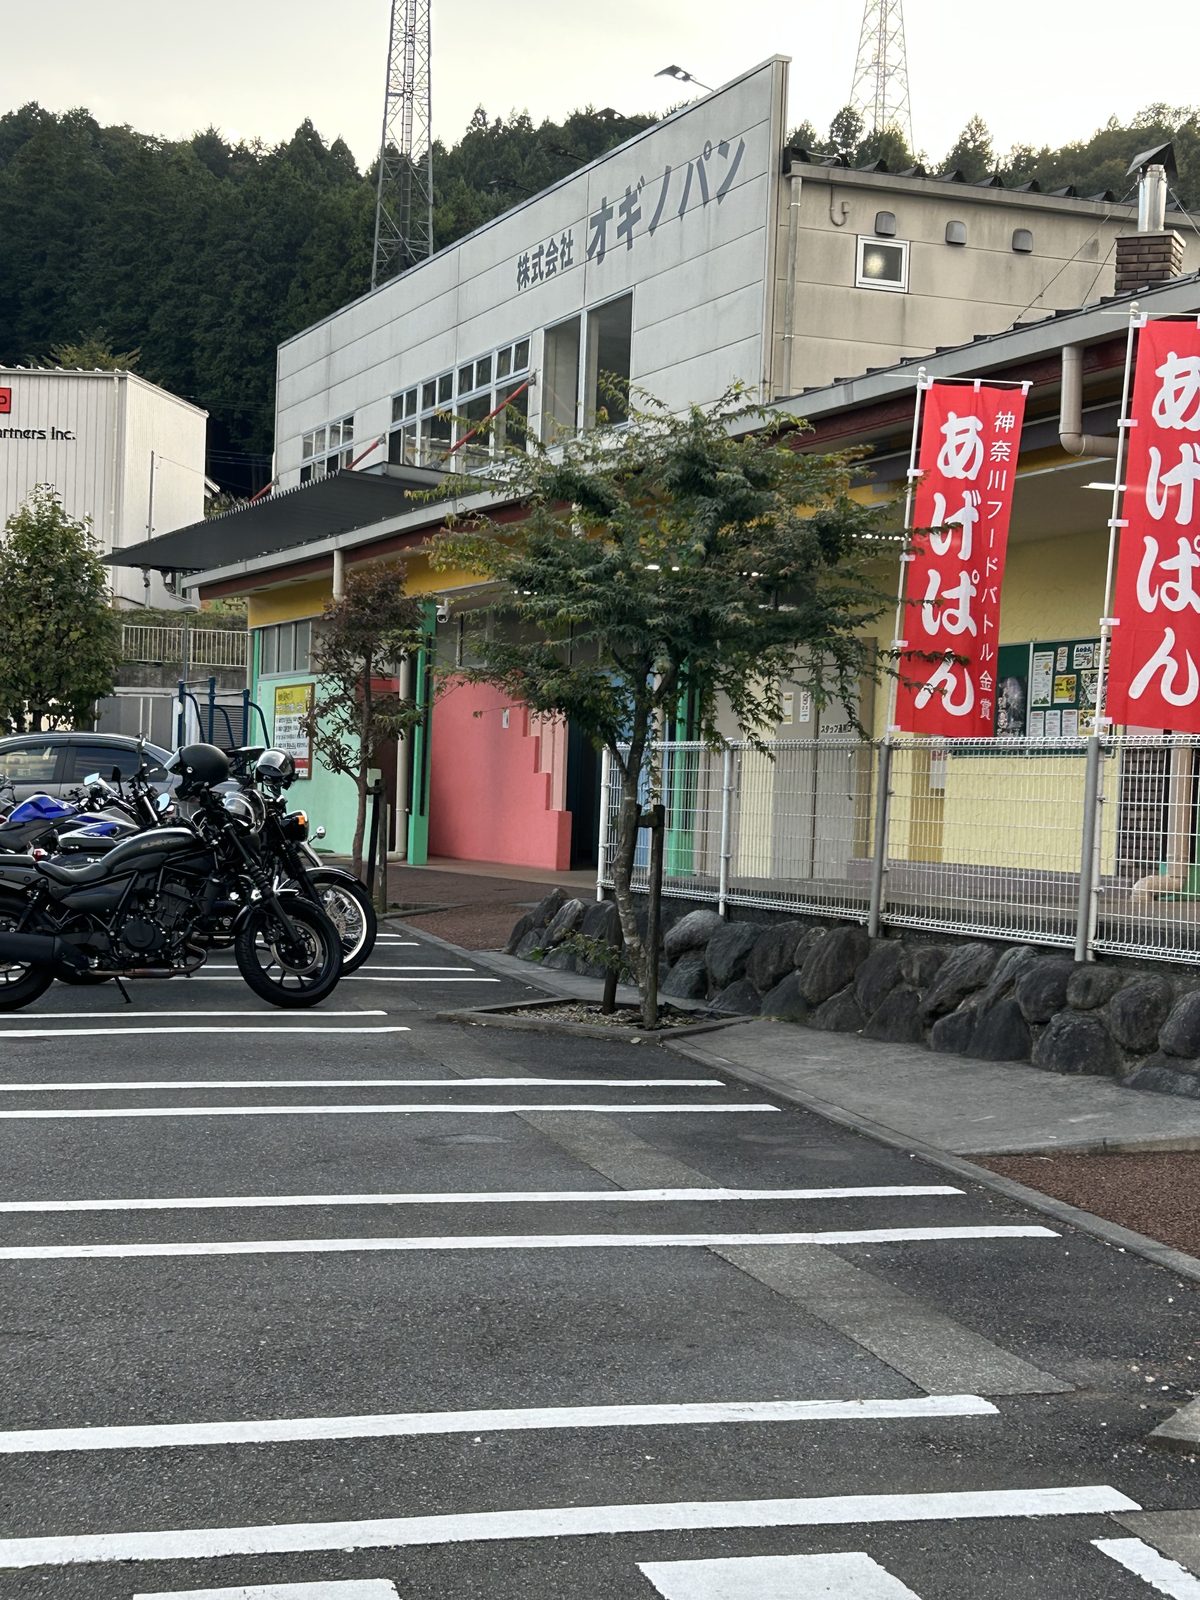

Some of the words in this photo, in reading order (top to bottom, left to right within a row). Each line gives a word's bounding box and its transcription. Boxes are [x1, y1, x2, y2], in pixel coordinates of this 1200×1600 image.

[517, 229, 574, 292] 株式会社
[586, 136, 745, 266] オギノパン
[51, 426, 76, 440] Inc.
[914, 410, 984, 717] あげぱん
[979, 410, 1015, 721] 神奈川フードバトル金賞
[1127, 350, 1200, 708] あげぱん
